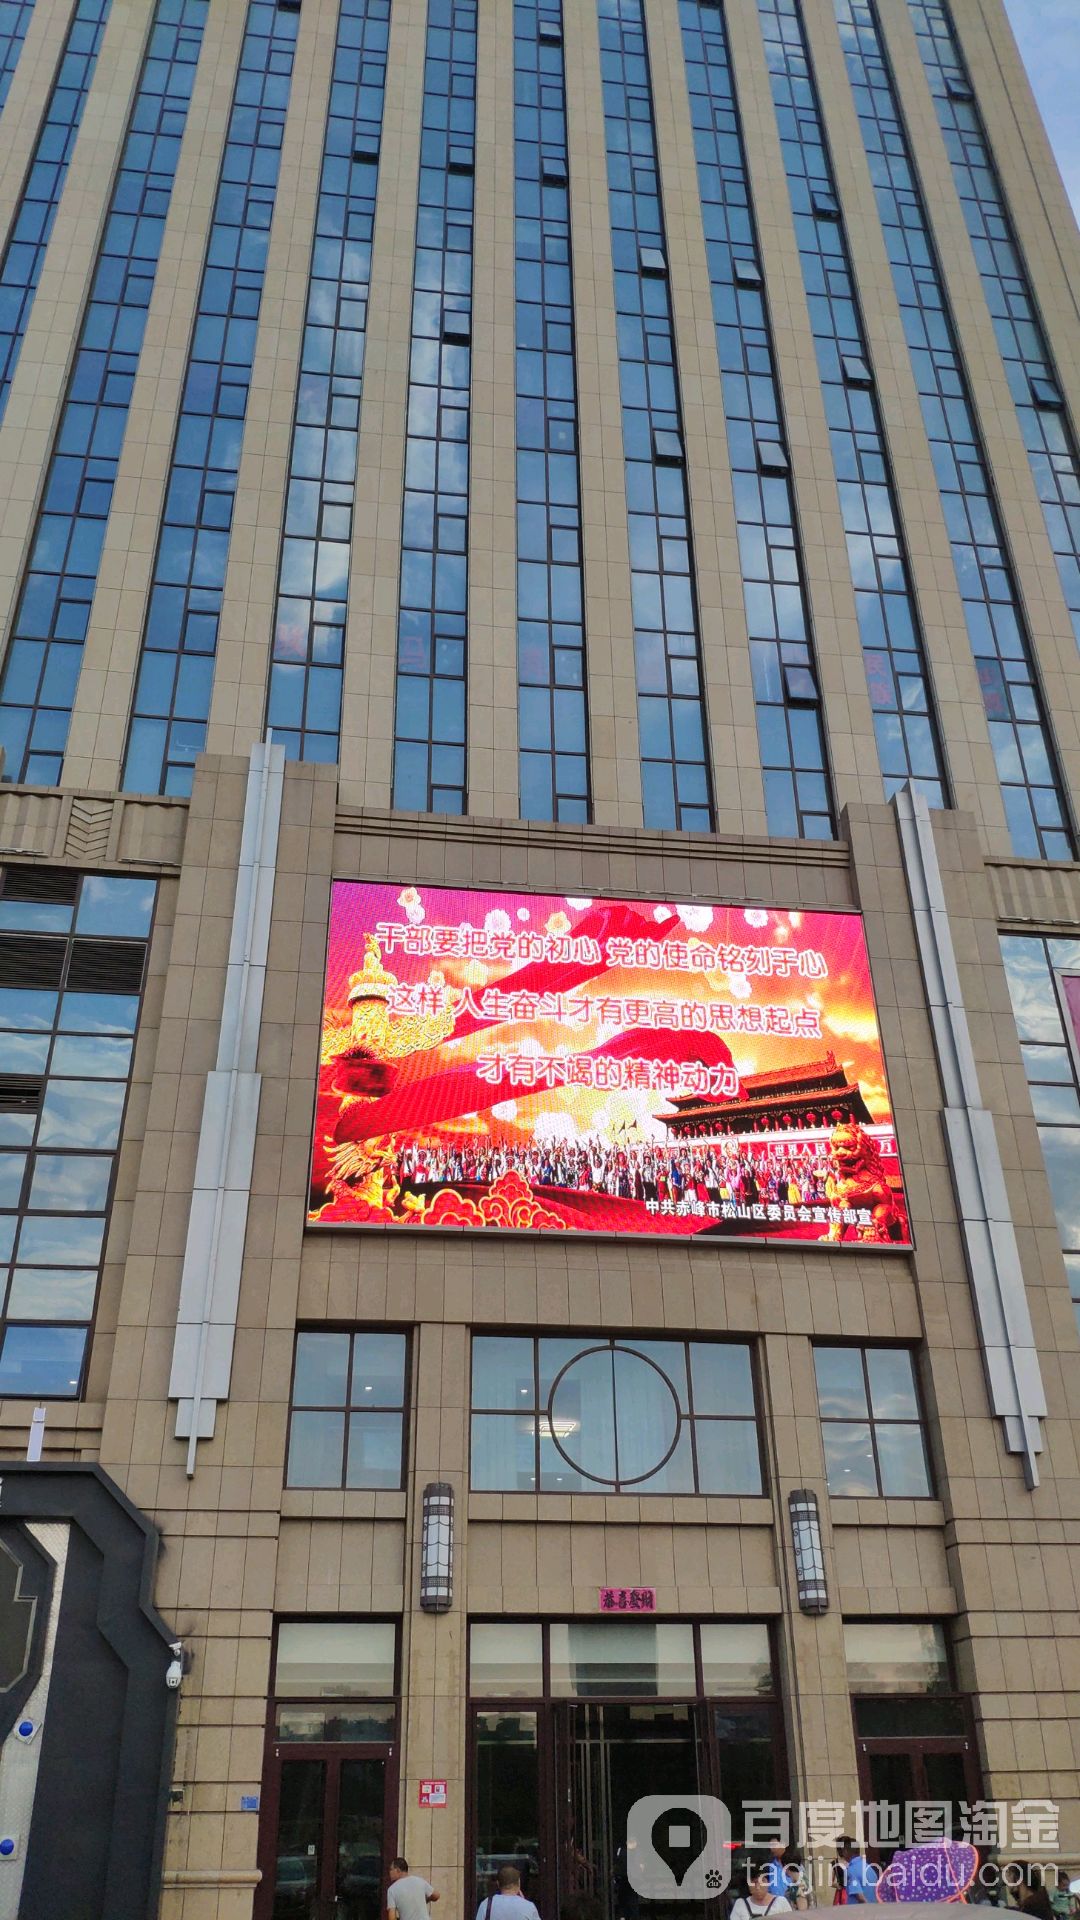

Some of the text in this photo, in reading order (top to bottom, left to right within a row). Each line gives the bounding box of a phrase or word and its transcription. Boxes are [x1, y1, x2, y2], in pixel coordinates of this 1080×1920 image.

[377, 922, 828, 978] 干部要把党的初心 党的使命铭刻于心
[386, 984, 822, 1039] 这样 人生奋斗才有更高的思想起点
[477, 1053, 739, 1096] 才有不竭的精神动力
[645, 1197, 873, 1227] 中共赤峰市松山区委员会宣传部宣
